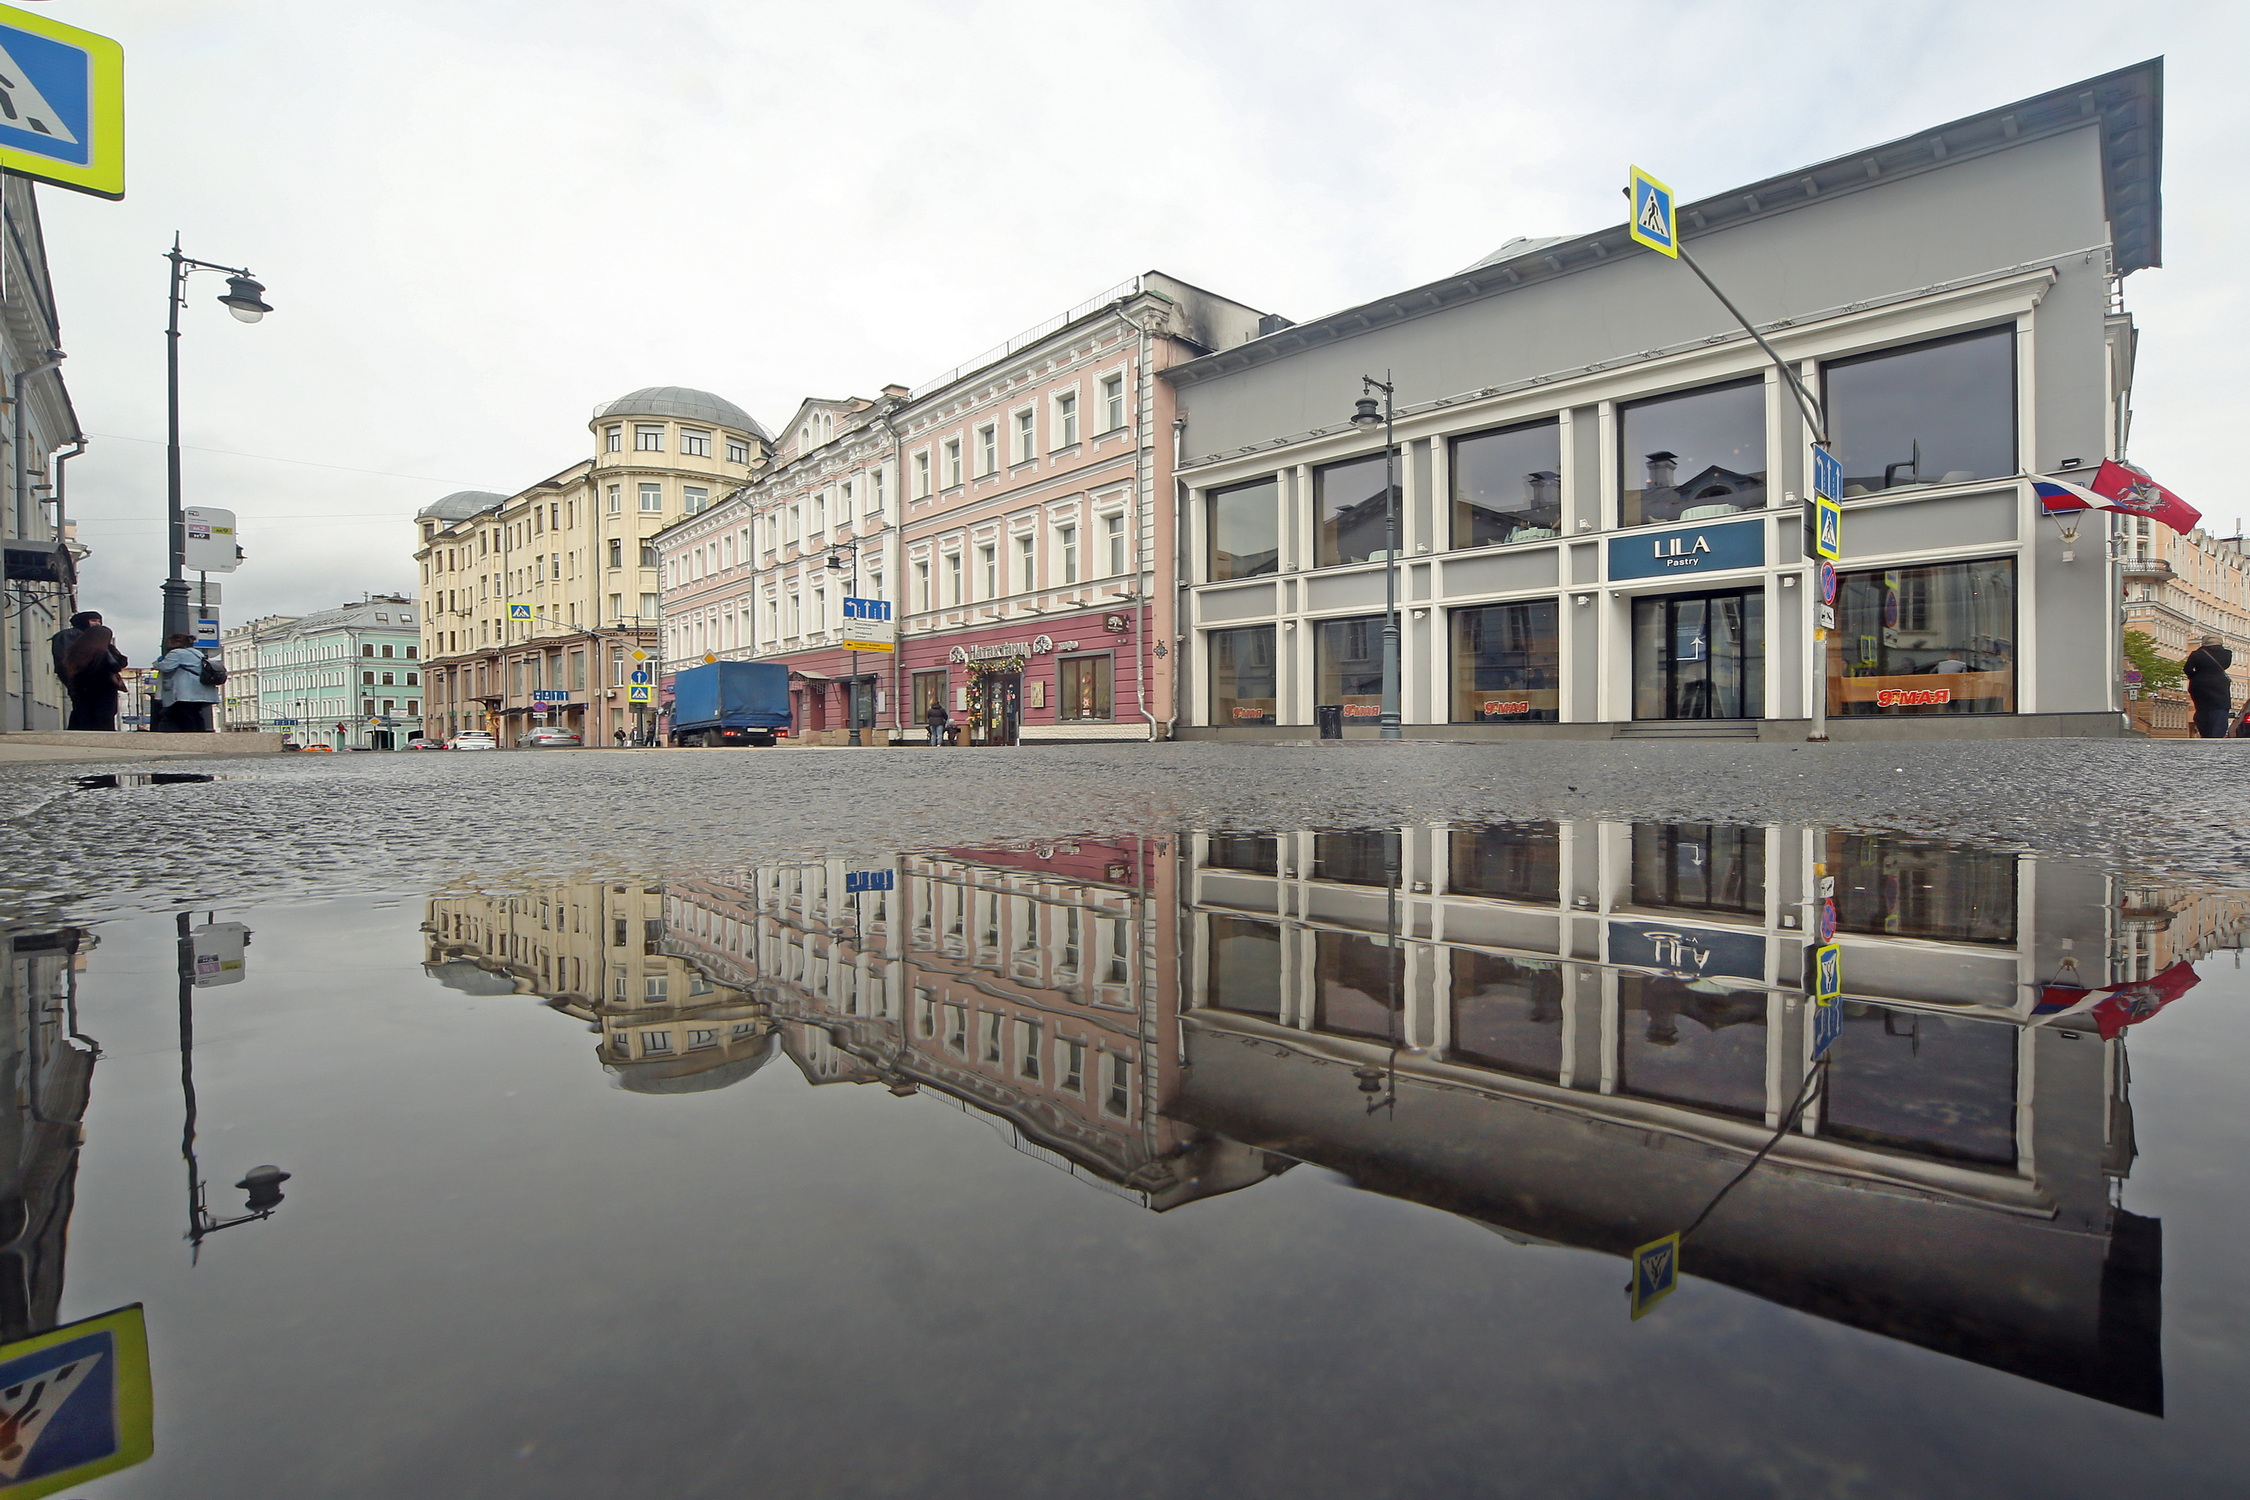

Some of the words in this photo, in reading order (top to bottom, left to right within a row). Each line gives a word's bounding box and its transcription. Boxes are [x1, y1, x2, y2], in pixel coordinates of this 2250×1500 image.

[1654, 535, 1711, 558] LILA
[1666, 558, 1699, 567] Pastry
[1899, 690, 1949, 705] МАЯ
